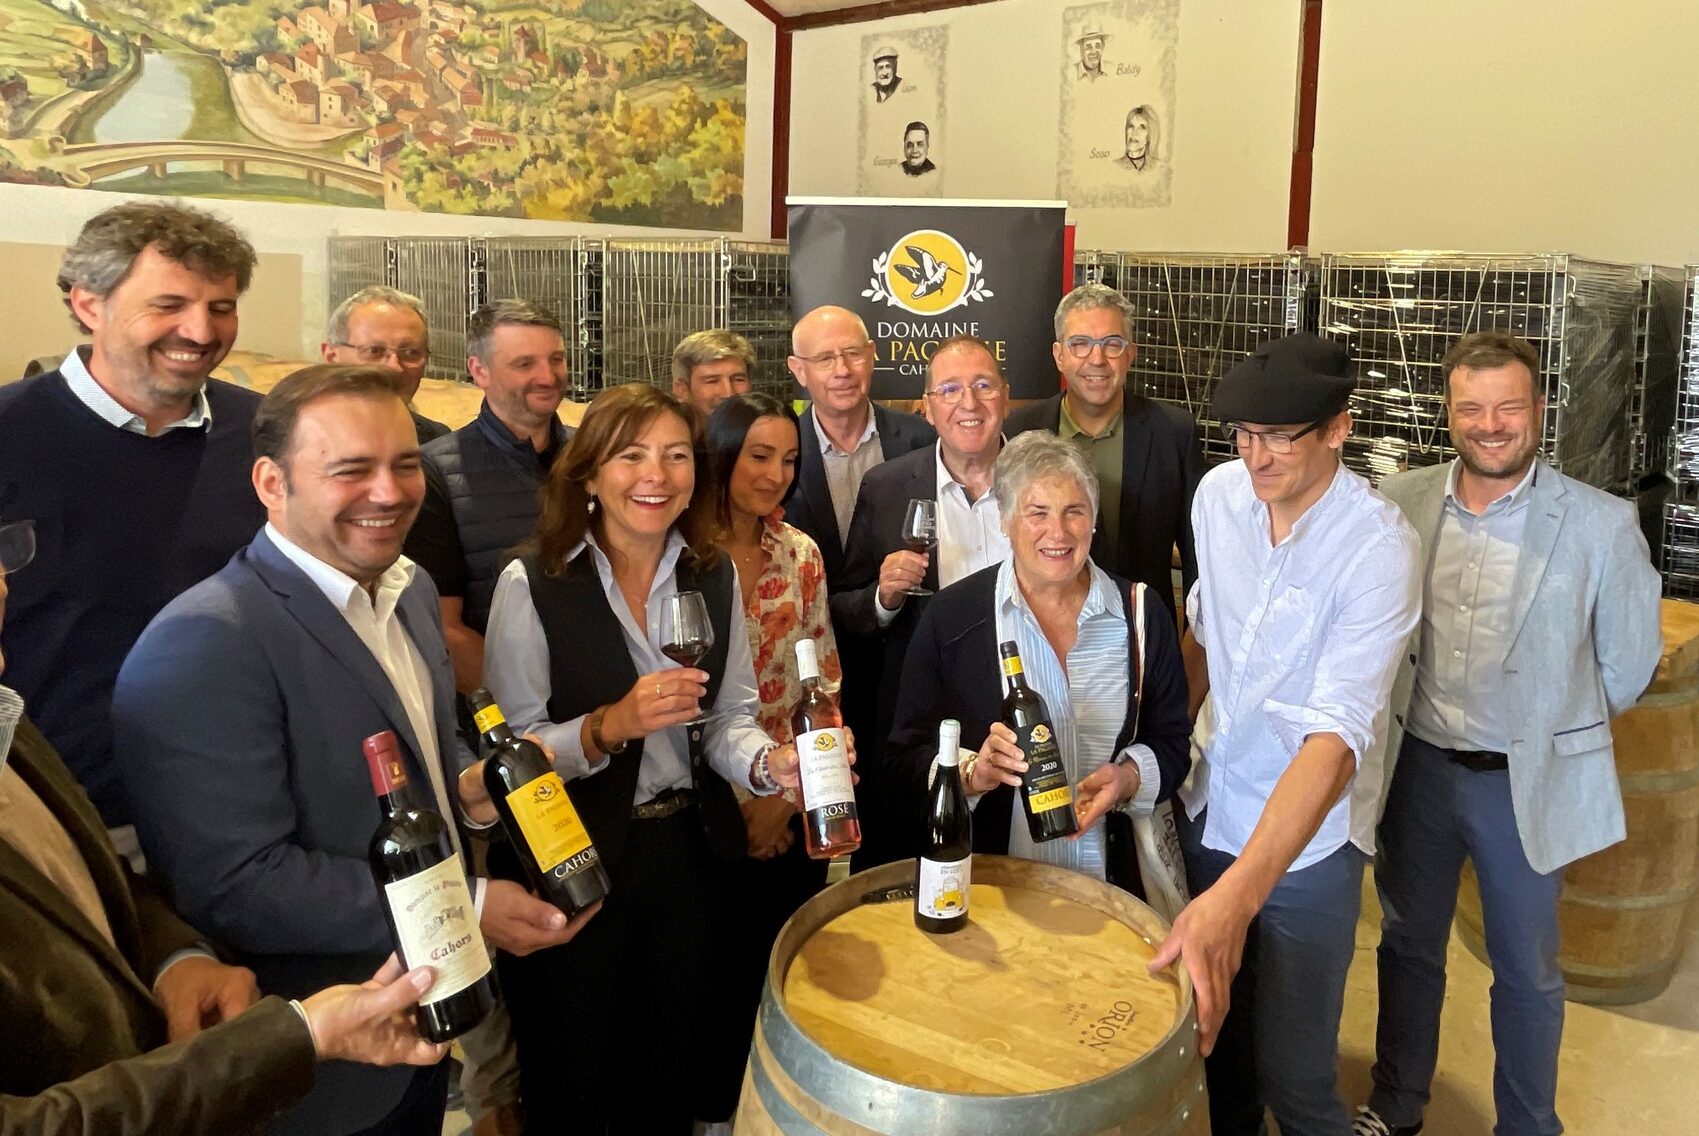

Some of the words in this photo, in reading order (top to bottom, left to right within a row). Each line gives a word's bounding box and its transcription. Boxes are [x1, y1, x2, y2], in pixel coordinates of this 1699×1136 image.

[877, 321, 979, 338] DOMAINE
[1041, 761, 1058, 772] 2020
[431, 933, 471, 961] Cahors
[1087, 1000, 1132, 1052] ORION
